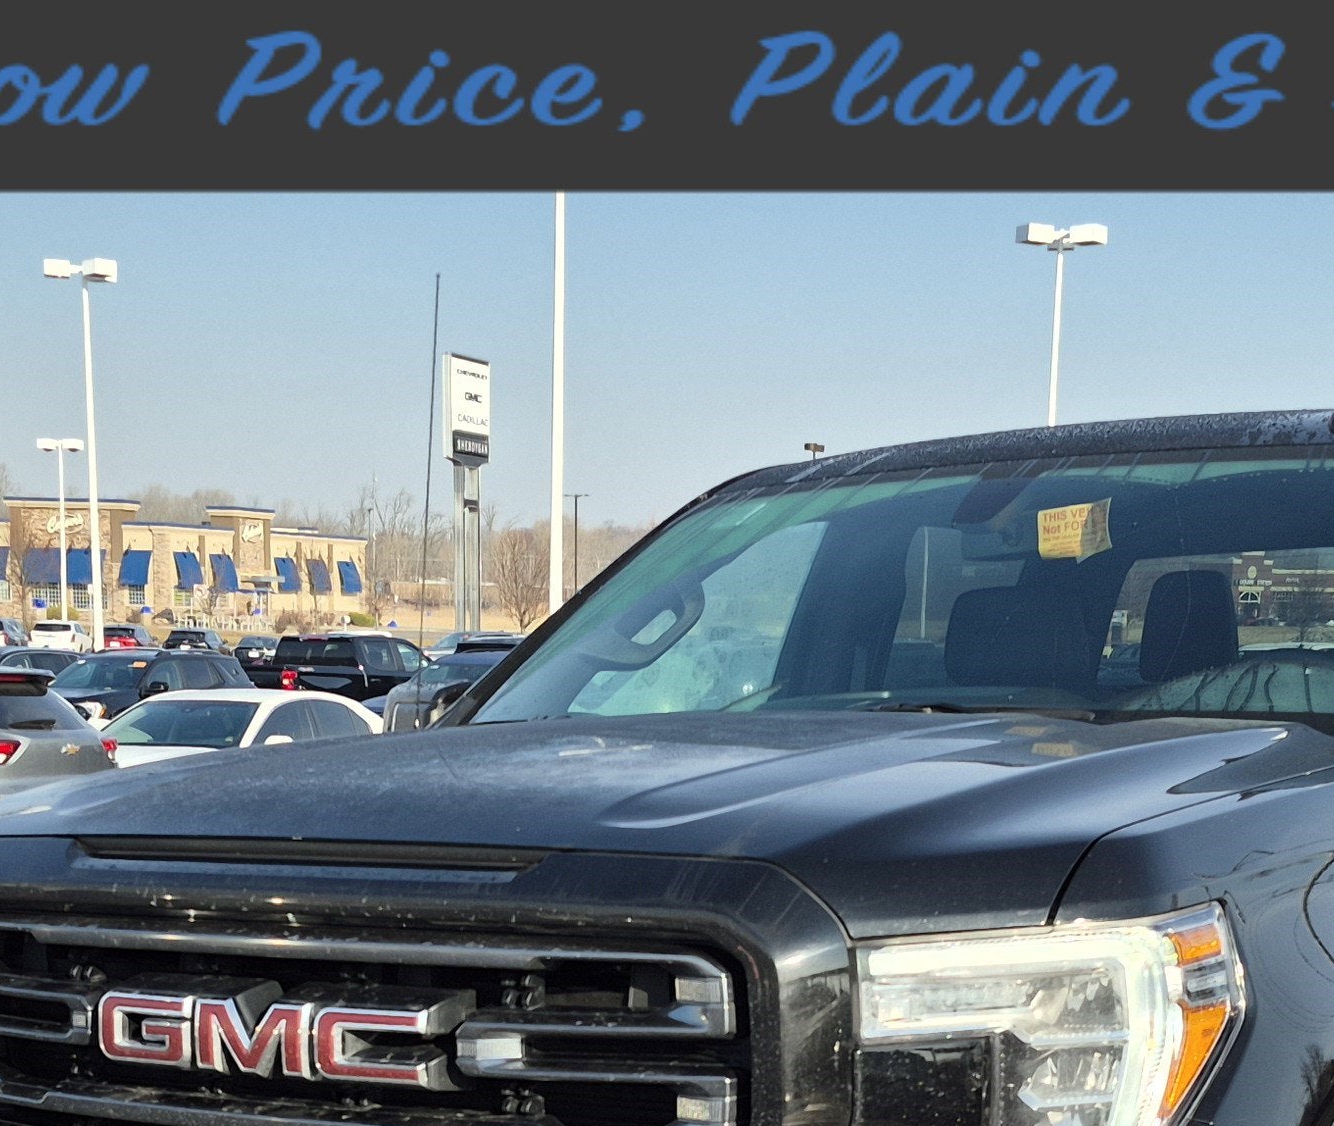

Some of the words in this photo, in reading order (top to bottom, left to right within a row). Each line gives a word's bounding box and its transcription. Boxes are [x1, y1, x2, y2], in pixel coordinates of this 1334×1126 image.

[464, 391, 483, 404] GMC
[457, 413, 489, 427] CADILLAC
[1043, 510, 1067, 523] THIS
[1042, 524, 1061, 535] Not
[97, 988, 442, 1092] GMC
